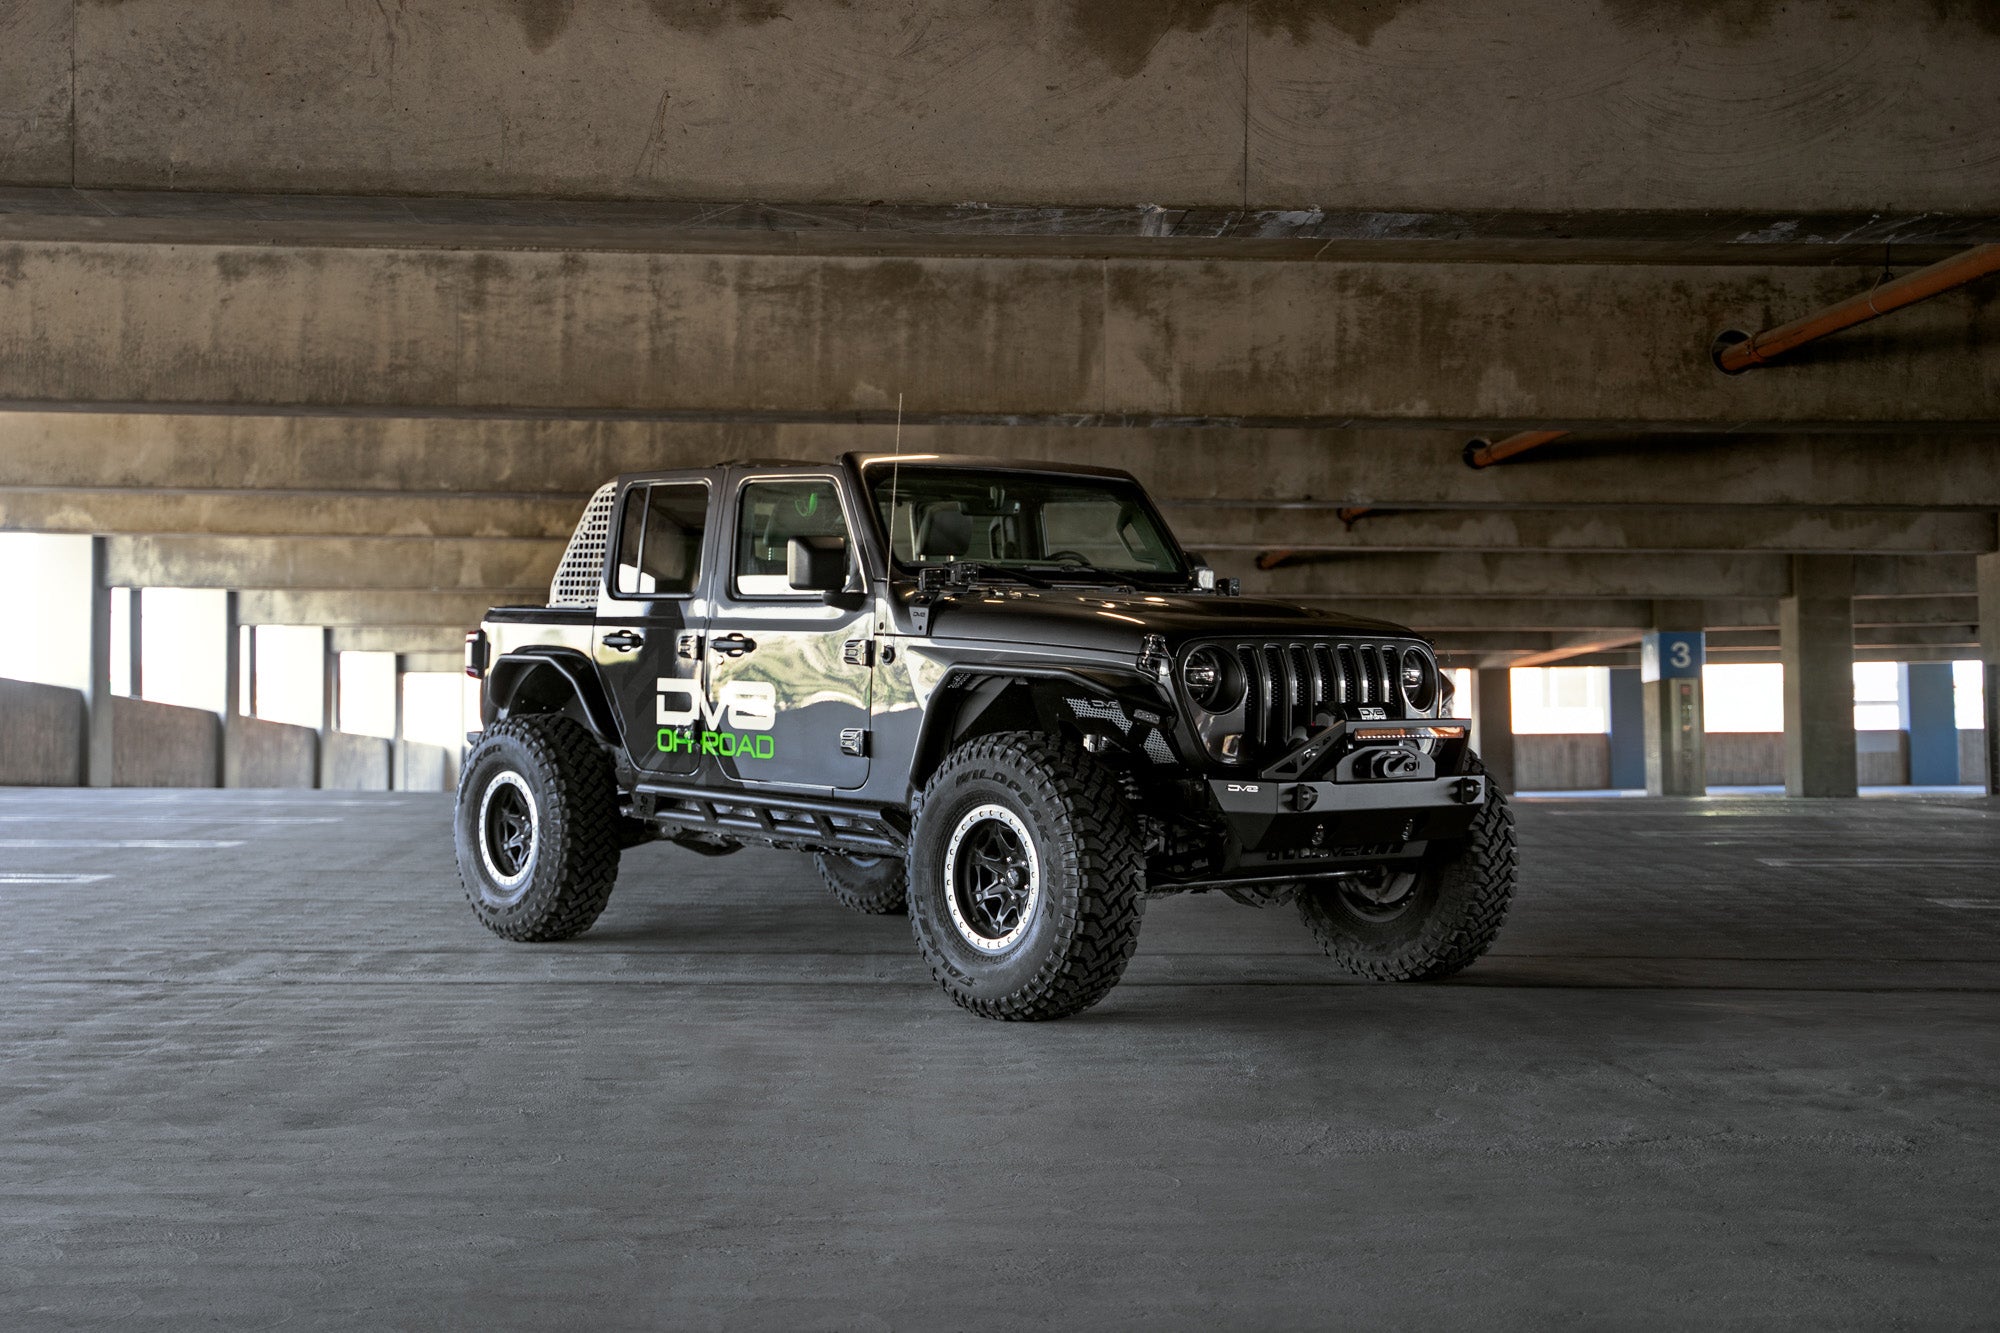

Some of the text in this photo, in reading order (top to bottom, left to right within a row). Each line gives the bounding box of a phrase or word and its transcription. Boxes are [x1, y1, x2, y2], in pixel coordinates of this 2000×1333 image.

[1670, 641, 1692, 669] 3
[657, 677, 776, 731] DV8
[701, 731, 775, 760] ROAD
[1227, 784, 1259, 793] DV8
